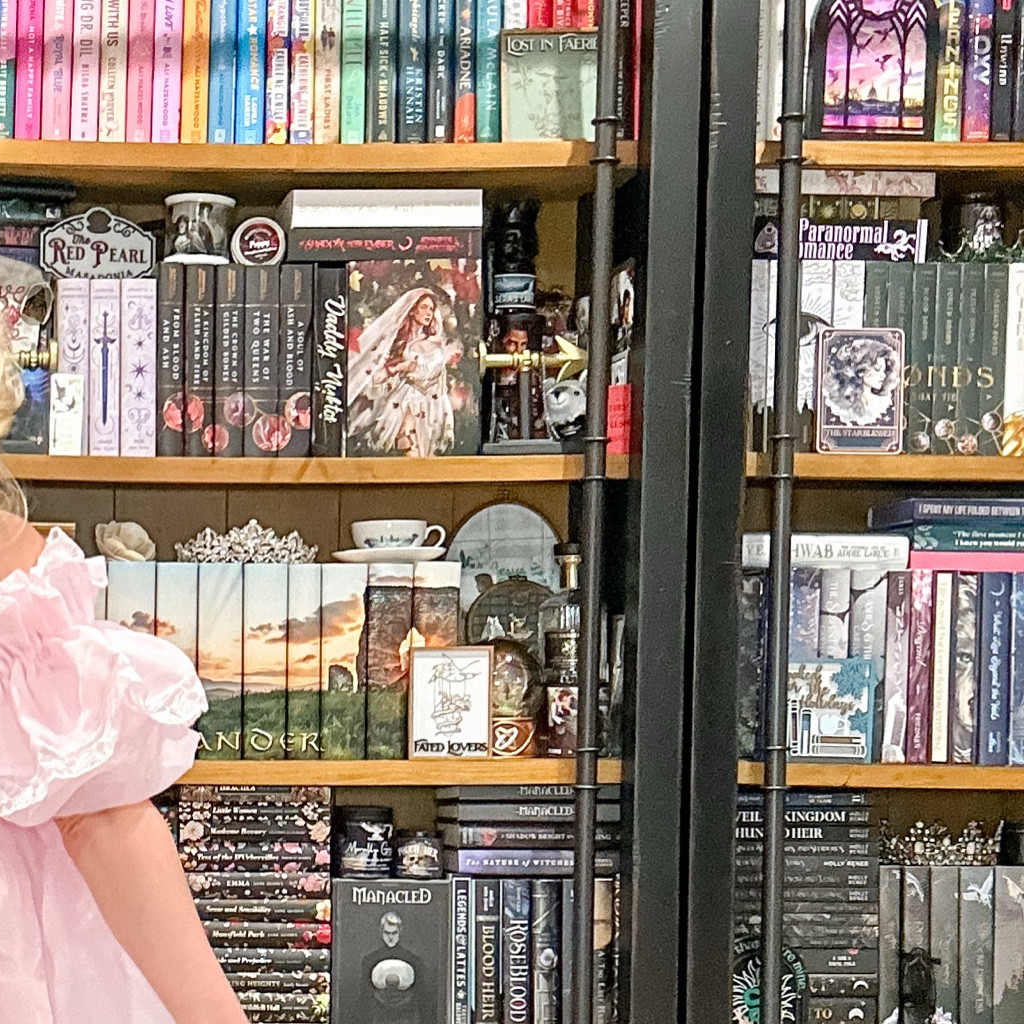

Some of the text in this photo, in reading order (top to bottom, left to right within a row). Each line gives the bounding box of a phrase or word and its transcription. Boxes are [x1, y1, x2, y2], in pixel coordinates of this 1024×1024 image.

[80, 39, 93, 57] DIL
[107, 32, 118, 47] US
[507, 37, 534, 56] LOST
[541, 38, 553, 52] IN
[249, 37, 259, 91] ROMANCE
[437, 50, 445, 79] DARK
[460, 26, 471, 90] ARIADNE
[108, 57, 116, 90] COLLEEN
[274, 48, 286, 120] KATHERINE CENTER
[378, 21, 389, 125] HALF SICK SHADOWS
[297, 53, 310, 127] KATHERINE CENTER
[405, 66, 414, 124] HANNAH
[414, 68, 423, 123] KRISTIN
[72, 234, 92, 246] The
[799, 218, 889, 243] Paranormal
[48, 238, 148, 271] RED PEARL
[286, 307, 294, 325] ASH
[317, 295, 346, 359] Daddy
[162, 319, 170, 343] AND
[286, 329, 294, 350] AND
[250, 311, 260, 383] TWO QUEENS
[172, 343, 180, 380] BLOOD
[286, 354, 294, 386] BLOOD
[297, 359, 303, 372] OF
[203, 370, 208, 382] OF
[231, 371, 237, 382] OF
[263, 367, 269, 381] OF
[942, 505, 989, 516] MY LIFE FOLDED
[414, 739, 488, 756] FATED LOVERS
[233, 806, 258, 815] Women
[796, 828, 823, 839] HEIR
[522, 858, 532, 867] of
[226, 879, 250, 887] EMMA
[352, 887, 431, 905] MANACLED
[248, 930, 265, 938] Park
[456, 889, 467, 987] LEGENDS LATTES
[482, 925, 495, 1020] BLOOD HEIR
